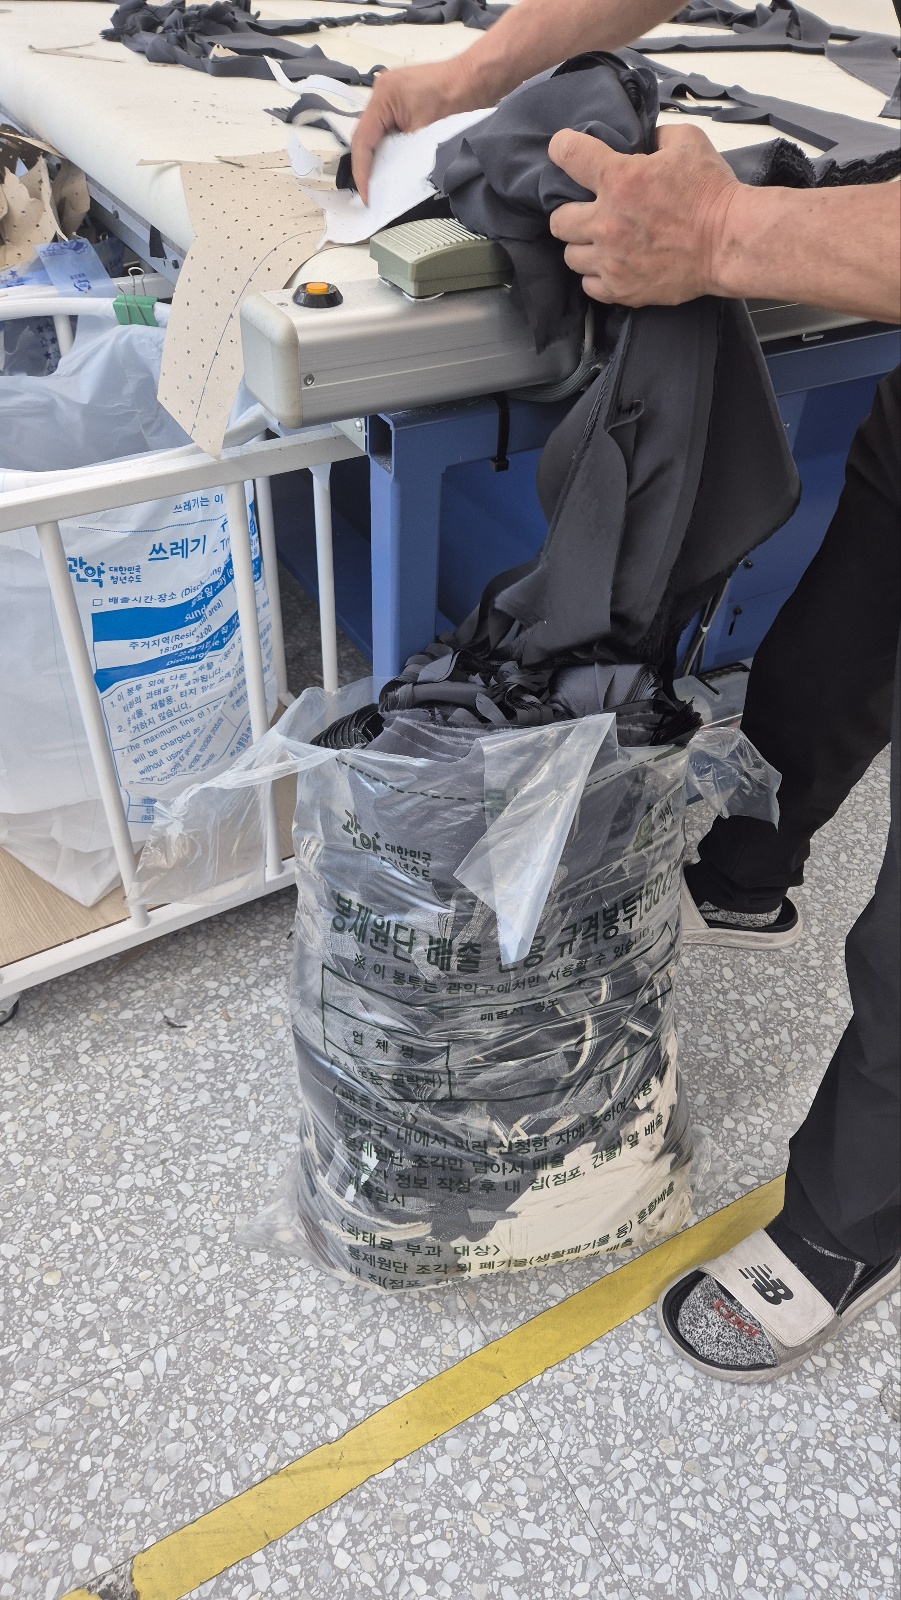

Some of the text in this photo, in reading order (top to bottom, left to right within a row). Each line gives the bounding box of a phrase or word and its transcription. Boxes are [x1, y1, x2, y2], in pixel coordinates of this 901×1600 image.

[173, 496, 210, 513] 쓰레기는
[148, 535, 206, 561] 쓰레기
[67, 556, 106, 588] 관악
[108, 565, 142, 575] 대한민국
[110, 574, 142, 585] 청년수도
[160, 642, 183, 655] 18:00
[143, 724, 178, 746] maximum
[179, 717, 195, 727] fine
[197, 710, 205, 719] of
[132, 753, 146, 765] will
[147, 748, 158, 757] be
[160, 731, 191, 751] charged
[139, 759, 165, 776] without
[384, 843, 432, 867] 대한민국
[332, 892, 416, 963] 봉제원단
[427, 935, 482, 974] 배출
[374, 964, 385, 979] 이
[393, 970, 438, 993] 봉투는
[446, 973, 541, 995] 관악구에서만
[343, 1112, 389, 1139] 관악구
[397, 1127, 447, 1149] 내에서
[496, 1136, 549, 1155] 신청한
[555, 1122, 585, 1145] 자에
[395, 1173, 429, 1190] 정보
[437, 1178, 471, 1194] 작성
[479, 1179, 496, 1193] 후
[504, 1180, 519, 1193] 내
[626, 1130, 639, 1149] 앞
[644, 1112, 663, 1137] 배출
[411, 1154, 463, 1171] 조각만
[472, 1161, 524, 1176] 담아서
[533, 1153, 566, 1170] 배출
[348, 1244, 408, 1274] 봉제원단
[415, 1263, 448, 1275] 조각
[455, 1262, 471, 1272] 외
[405, 1243, 442, 1257] 부과
